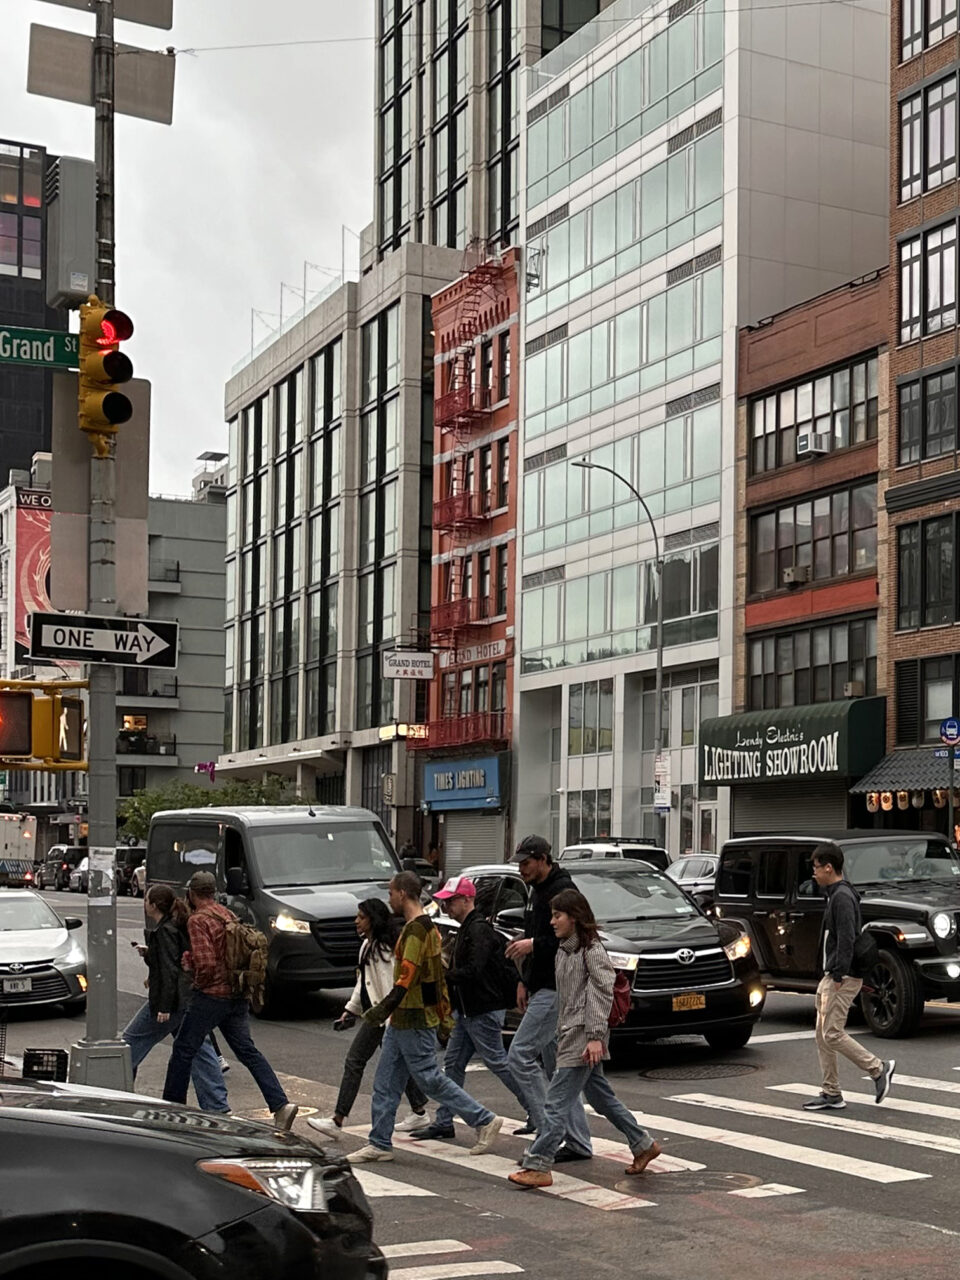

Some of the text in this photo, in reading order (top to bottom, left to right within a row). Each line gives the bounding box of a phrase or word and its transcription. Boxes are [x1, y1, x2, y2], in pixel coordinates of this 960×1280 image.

[0, 331, 77, 361] Grand St
[20, 494, 38, 504] WE
[53, 628, 155, 652] ONE WAY
[477, 642, 502, 659] HOTEL
[388, 659, 433, 669] GRAND HOTEL
[704, 745, 761, 780] LIGHTING
[766, 731, 839, 776] SHOWROOM
[434, 768, 484, 791] TIMES LIGHTING
